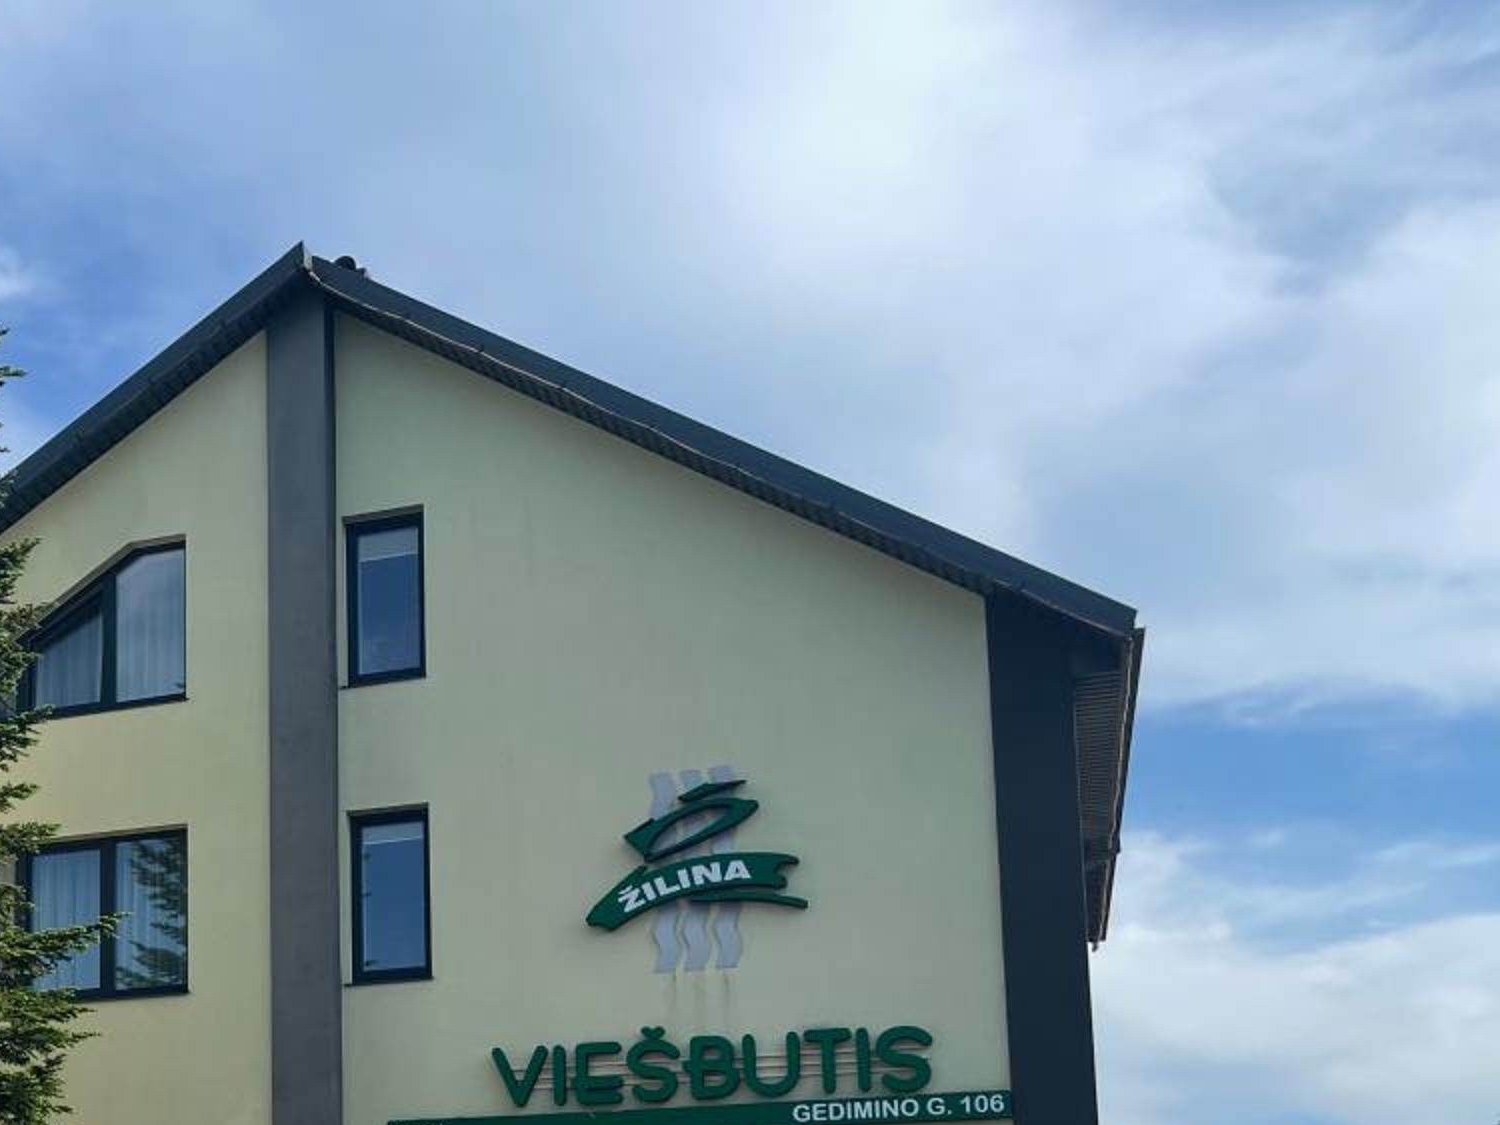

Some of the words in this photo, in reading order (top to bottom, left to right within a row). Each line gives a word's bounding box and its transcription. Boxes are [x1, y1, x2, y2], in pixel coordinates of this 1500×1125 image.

[618, 860, 751, 913] ŽILINA
[492, 1025, 933, 1107] VIEŠBUTIS
[792, 1099, 920, 1122] GEDIMINO
[926, 1097, 952, 1116] G.
[960, 1094, 1005, 1113] 106
